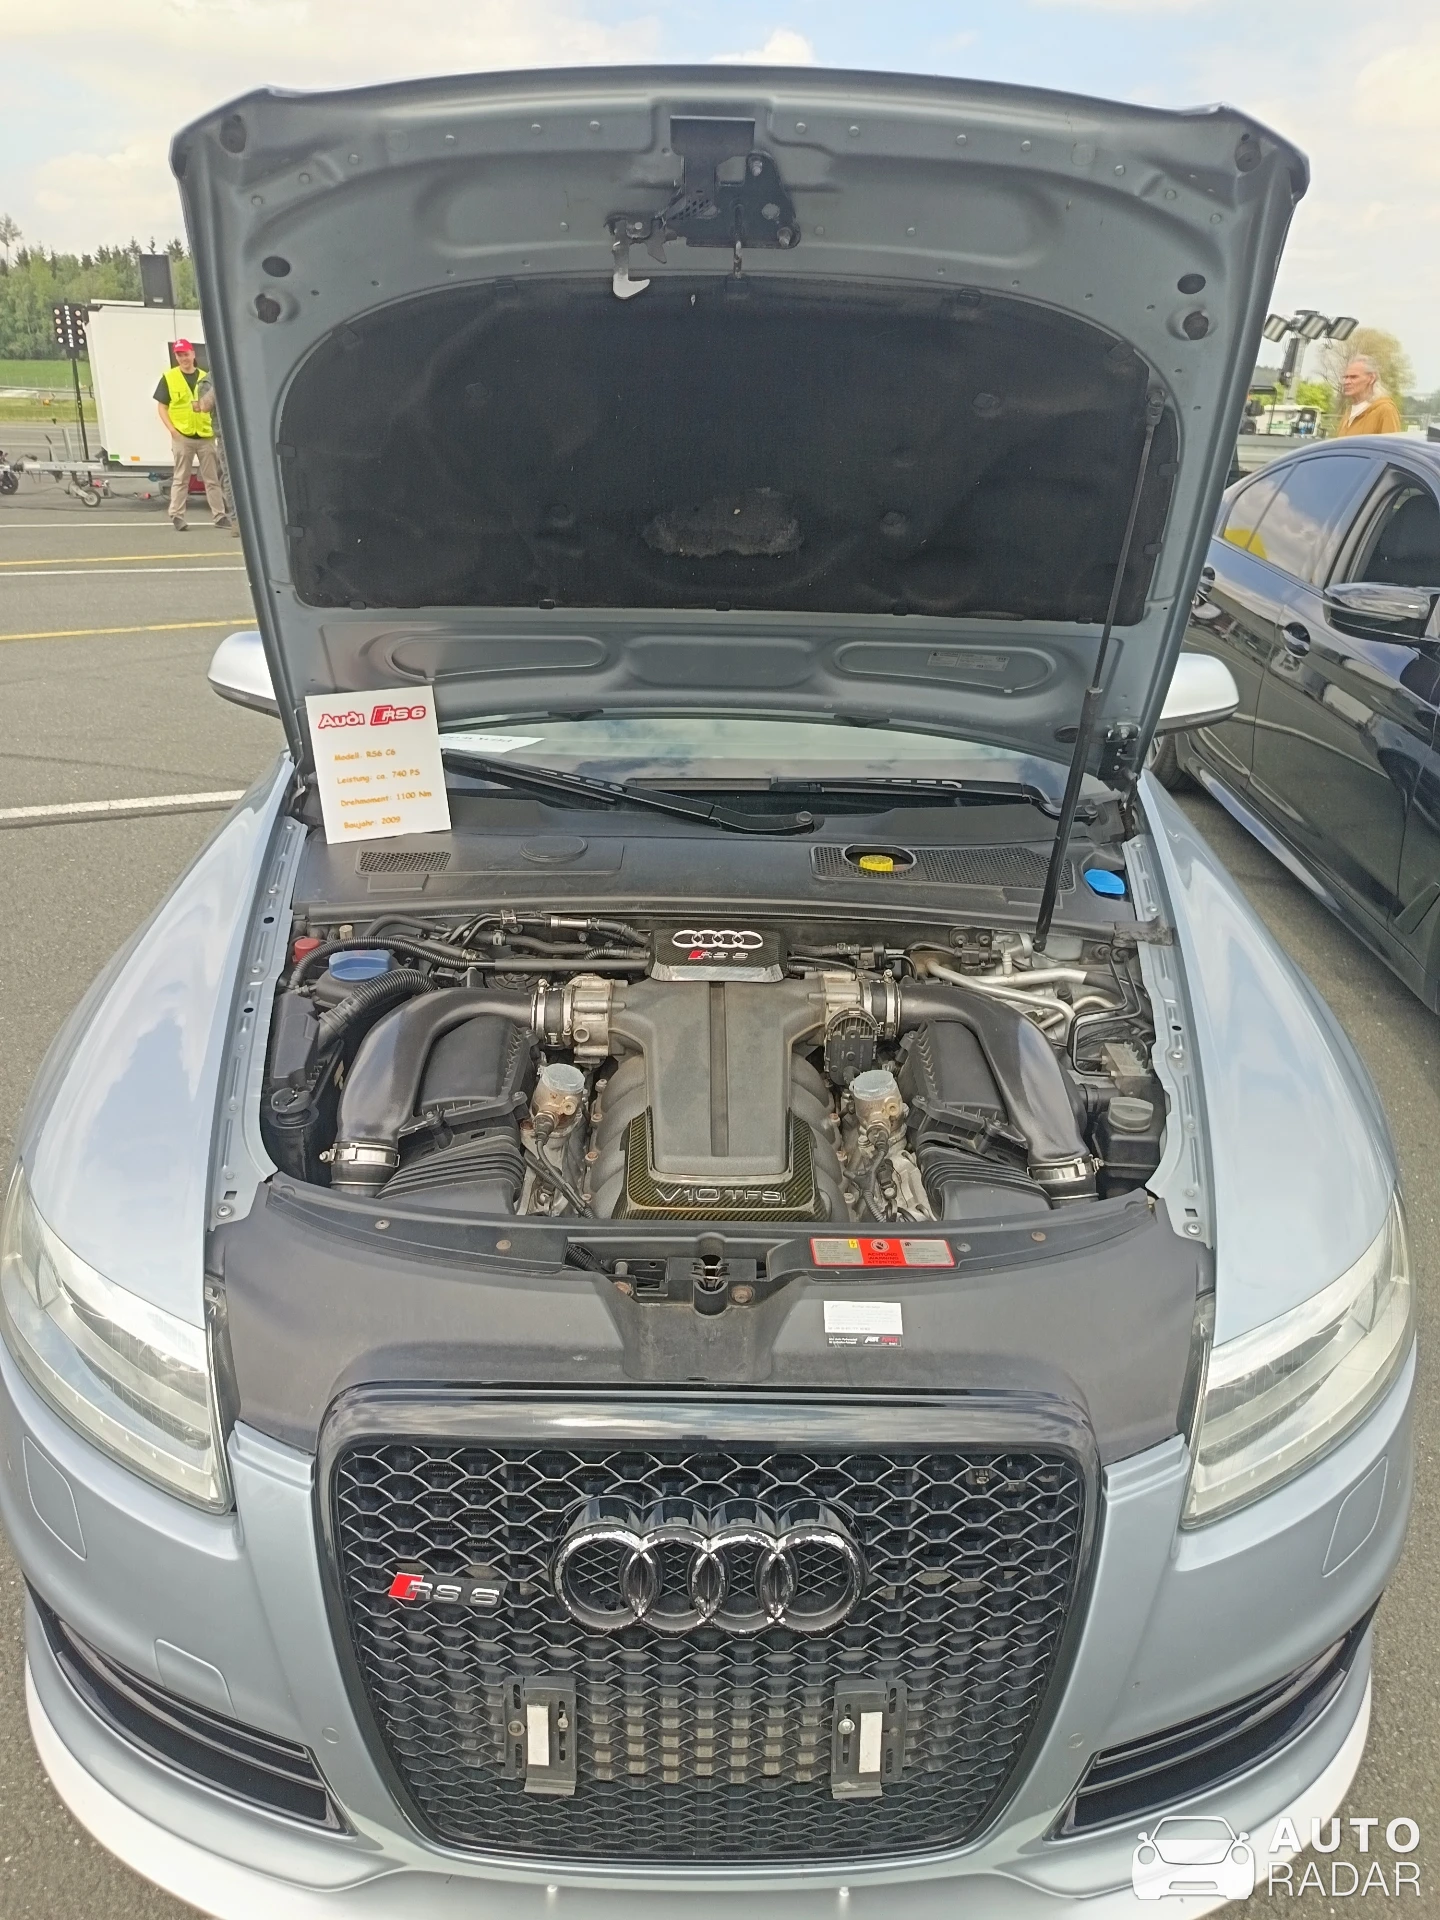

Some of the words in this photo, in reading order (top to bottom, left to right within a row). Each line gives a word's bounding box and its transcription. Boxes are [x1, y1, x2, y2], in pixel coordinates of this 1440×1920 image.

[318, 711, 365, 729] Audi
[366, 750, 382, 758] RS6
[385, 748, 396, 756] C6
[337, 774, 373, 784] Leistung:
[392, 769, 407, 778] 740
[409, 768, 421, 776] PS
[340, 795, 393, 807] Drehmoment:
[396, 791, 416, 800] 1100
[418, 790, 432, 798] Nm
[343, 820, 378, 829] Baujahr:
[381, 816, 401, 825] 2009
